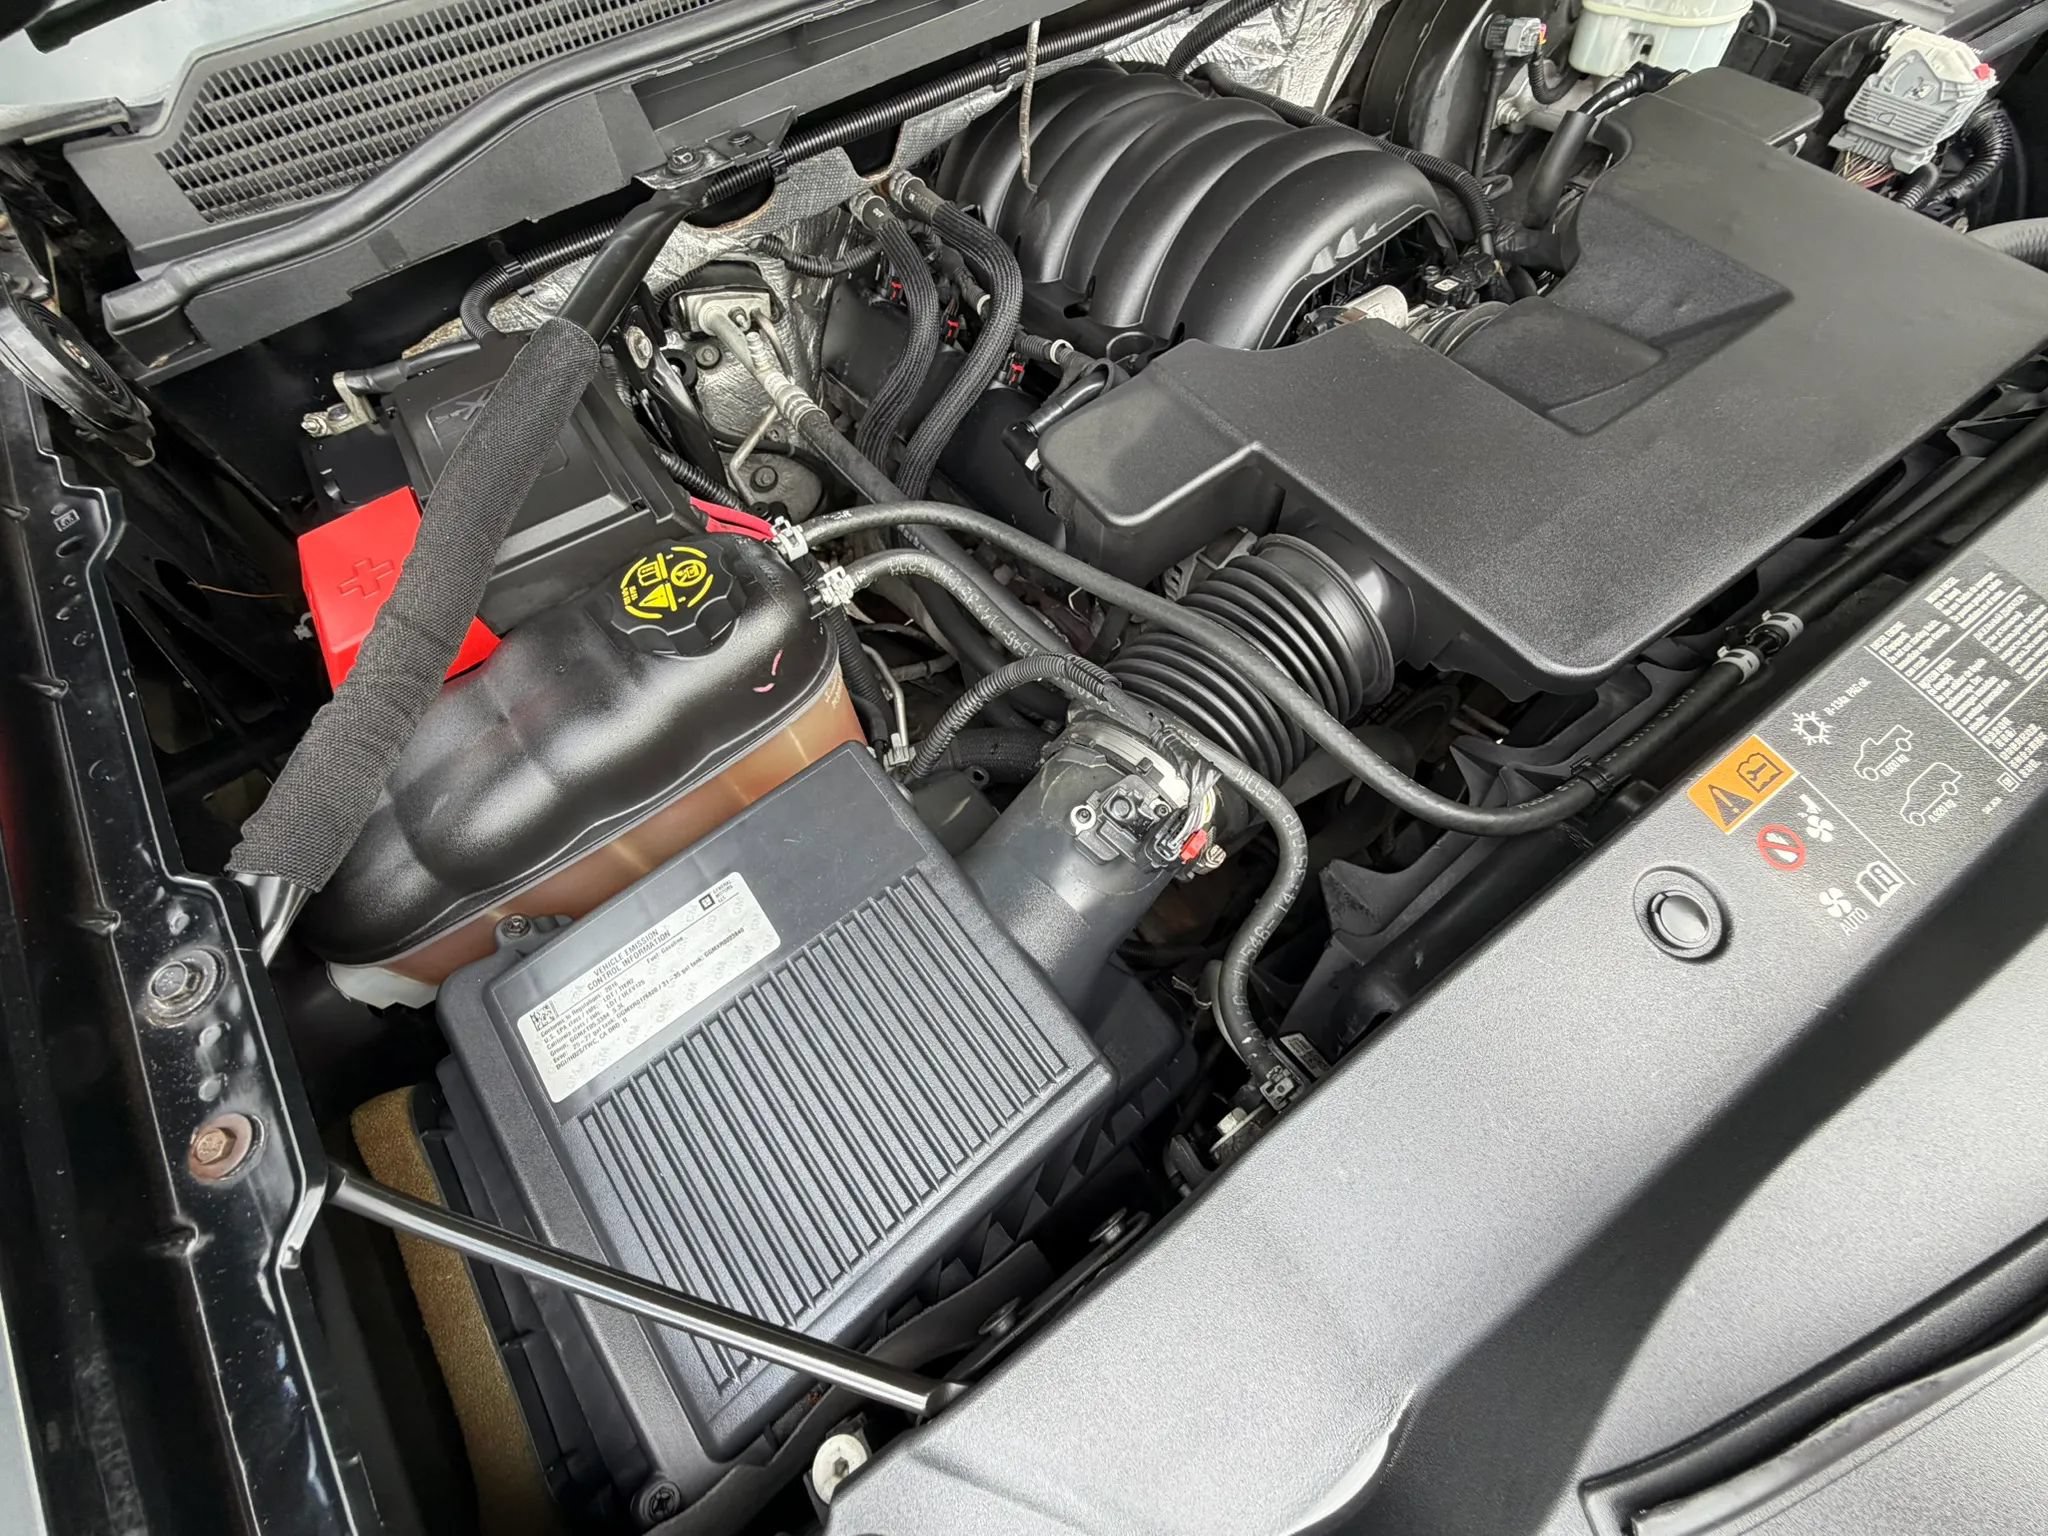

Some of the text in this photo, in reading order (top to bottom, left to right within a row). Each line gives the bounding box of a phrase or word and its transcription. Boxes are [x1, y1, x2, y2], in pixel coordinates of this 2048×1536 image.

[1840, 907, 1868, 936] AUTO
[587, 929, 671, 991] CONTROL INFORMATION
[594, 929, 659, 977] VEHICLE EMISSION
